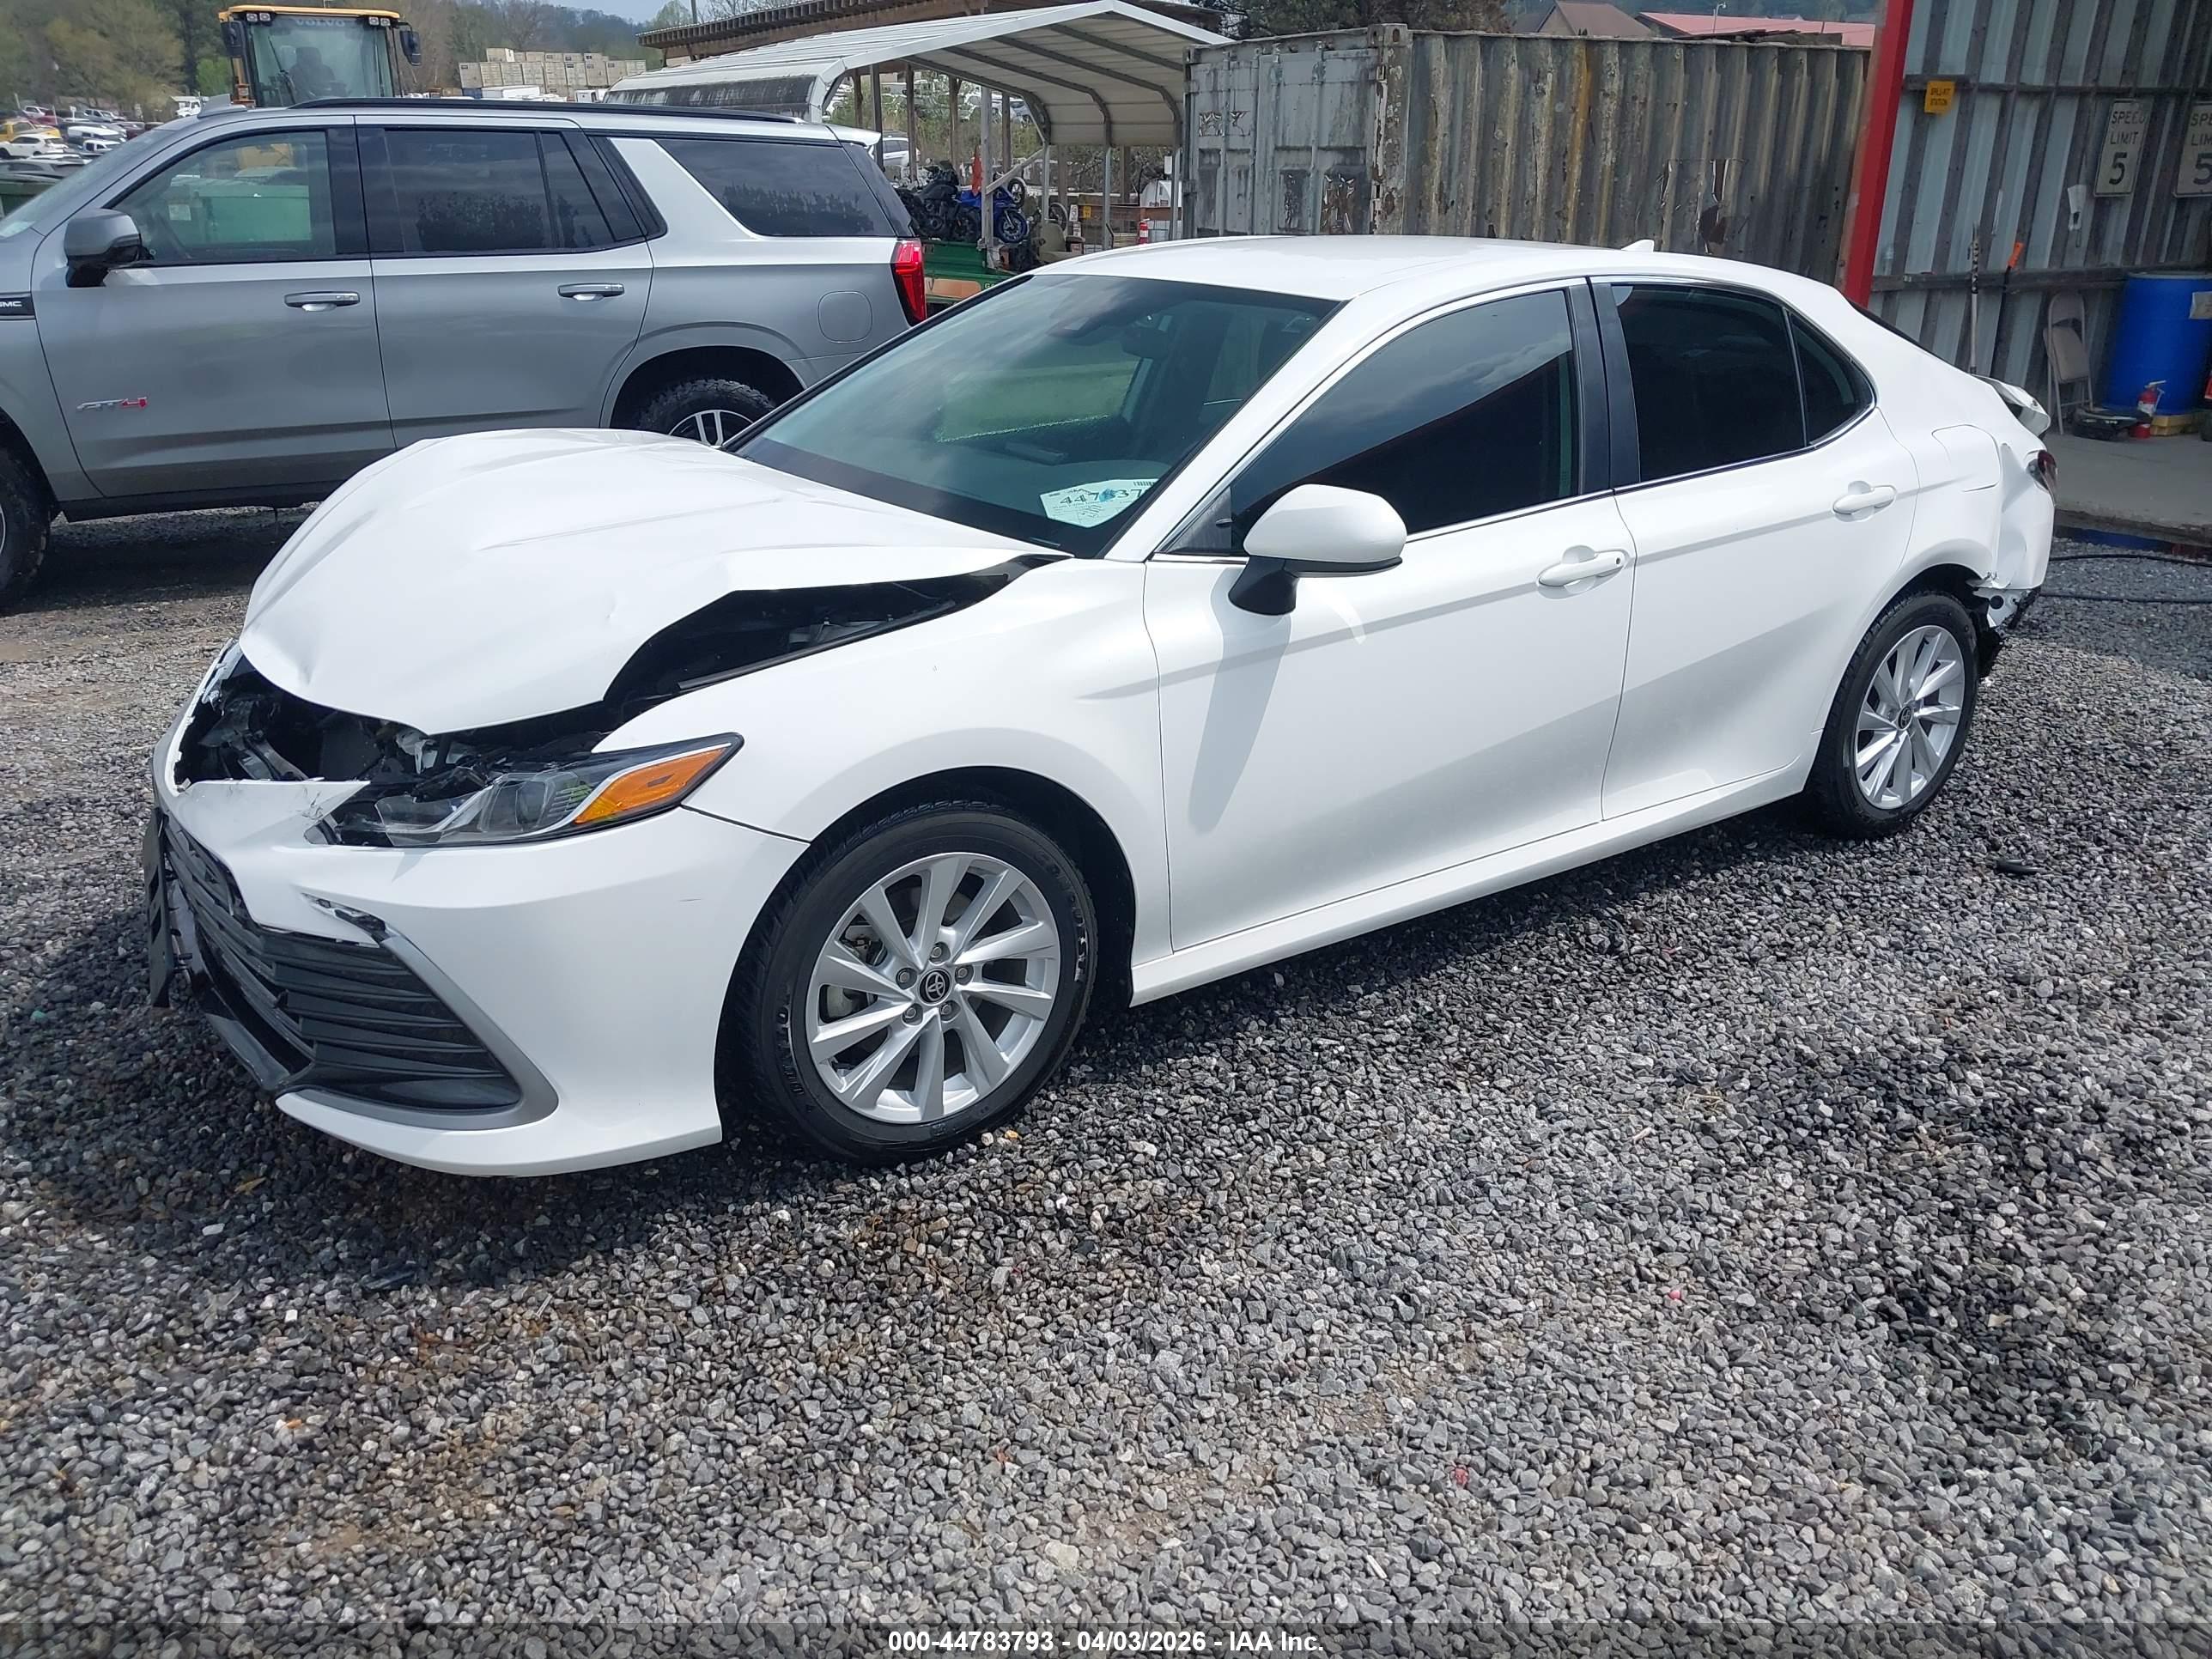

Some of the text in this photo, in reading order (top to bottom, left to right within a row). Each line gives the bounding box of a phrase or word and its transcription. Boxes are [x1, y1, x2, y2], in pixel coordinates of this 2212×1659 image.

[295, 19, 345, 27] VOLVO
[2112, 111, 2146, 125] SPEED
[2110, 131, 2139, 145] LIMIT
[2108, 152, 2128, 185] 5
[2192, 154, 2212, 185] 5
